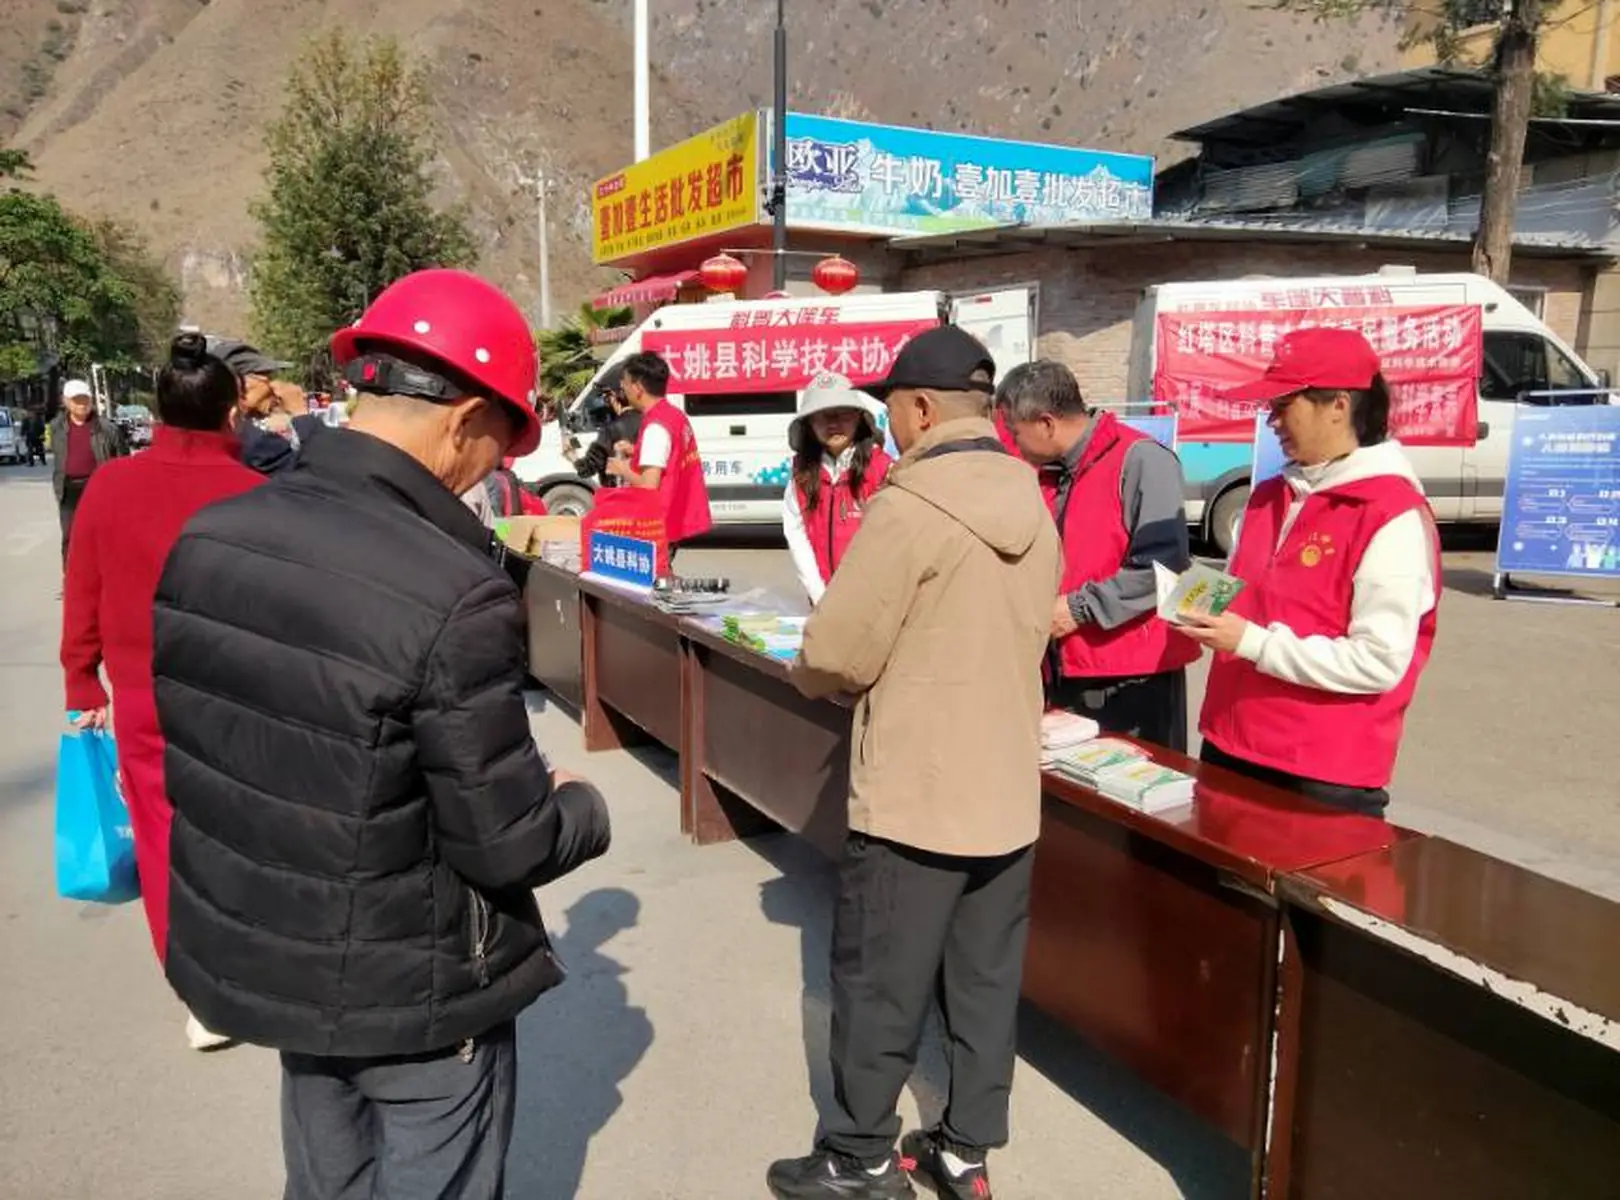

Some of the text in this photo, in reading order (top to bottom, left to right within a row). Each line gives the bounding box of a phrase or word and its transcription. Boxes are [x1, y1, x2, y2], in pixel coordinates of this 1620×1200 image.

[600, 152, 744, 243] 壹加壹生活批发超市
[787, 140, 858, 175] 欧亚
[870, 152, 944, 198] 牛奶
[955, 162, 1152, 220] 壹加壹批发超市
[592, 543, 651, 576] 大姚县科协
